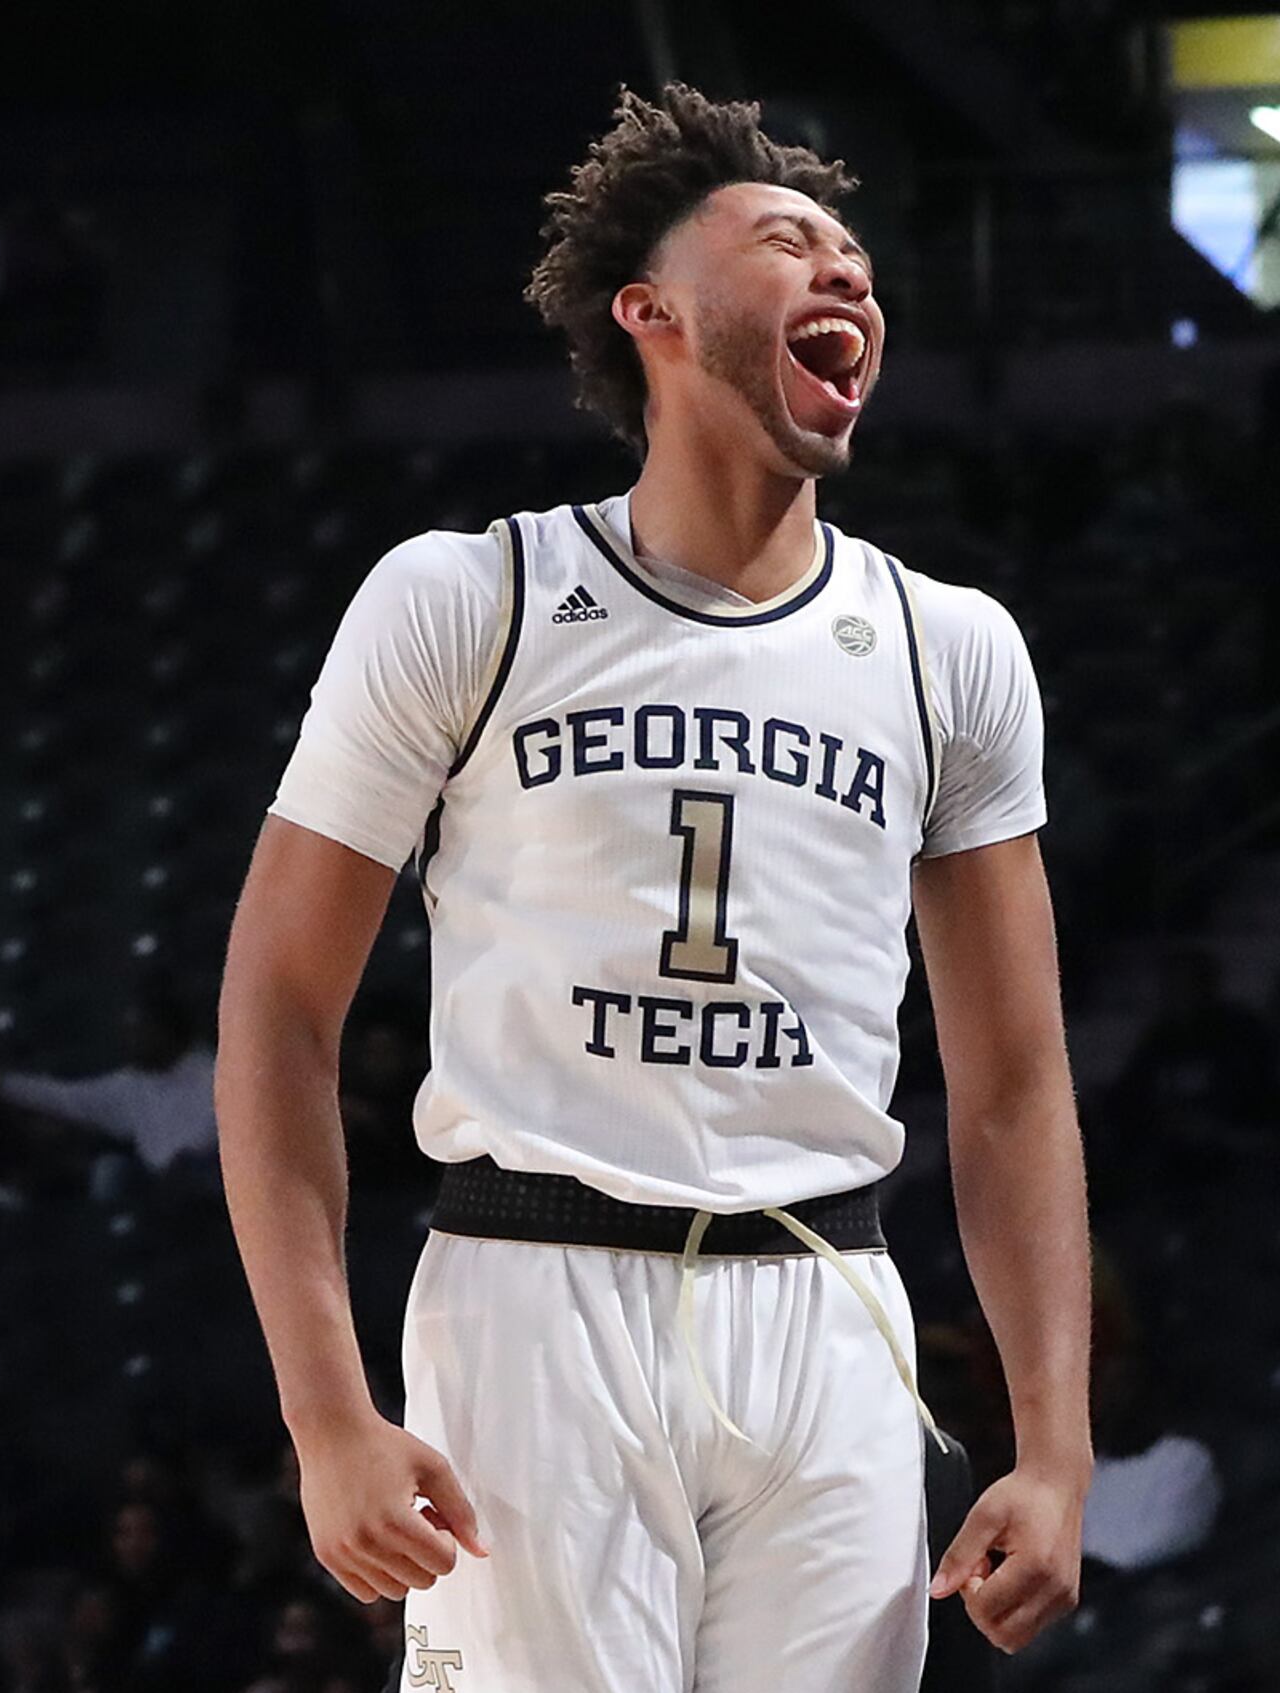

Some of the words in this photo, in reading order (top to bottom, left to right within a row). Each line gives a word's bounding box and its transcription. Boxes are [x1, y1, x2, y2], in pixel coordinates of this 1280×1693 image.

[552, 607, 609, 624] adidas
[512, 704, 887, 830] GEORGIA
[658, 788, 739, 985] 1
[572, 985, 815, 1069] TECH
